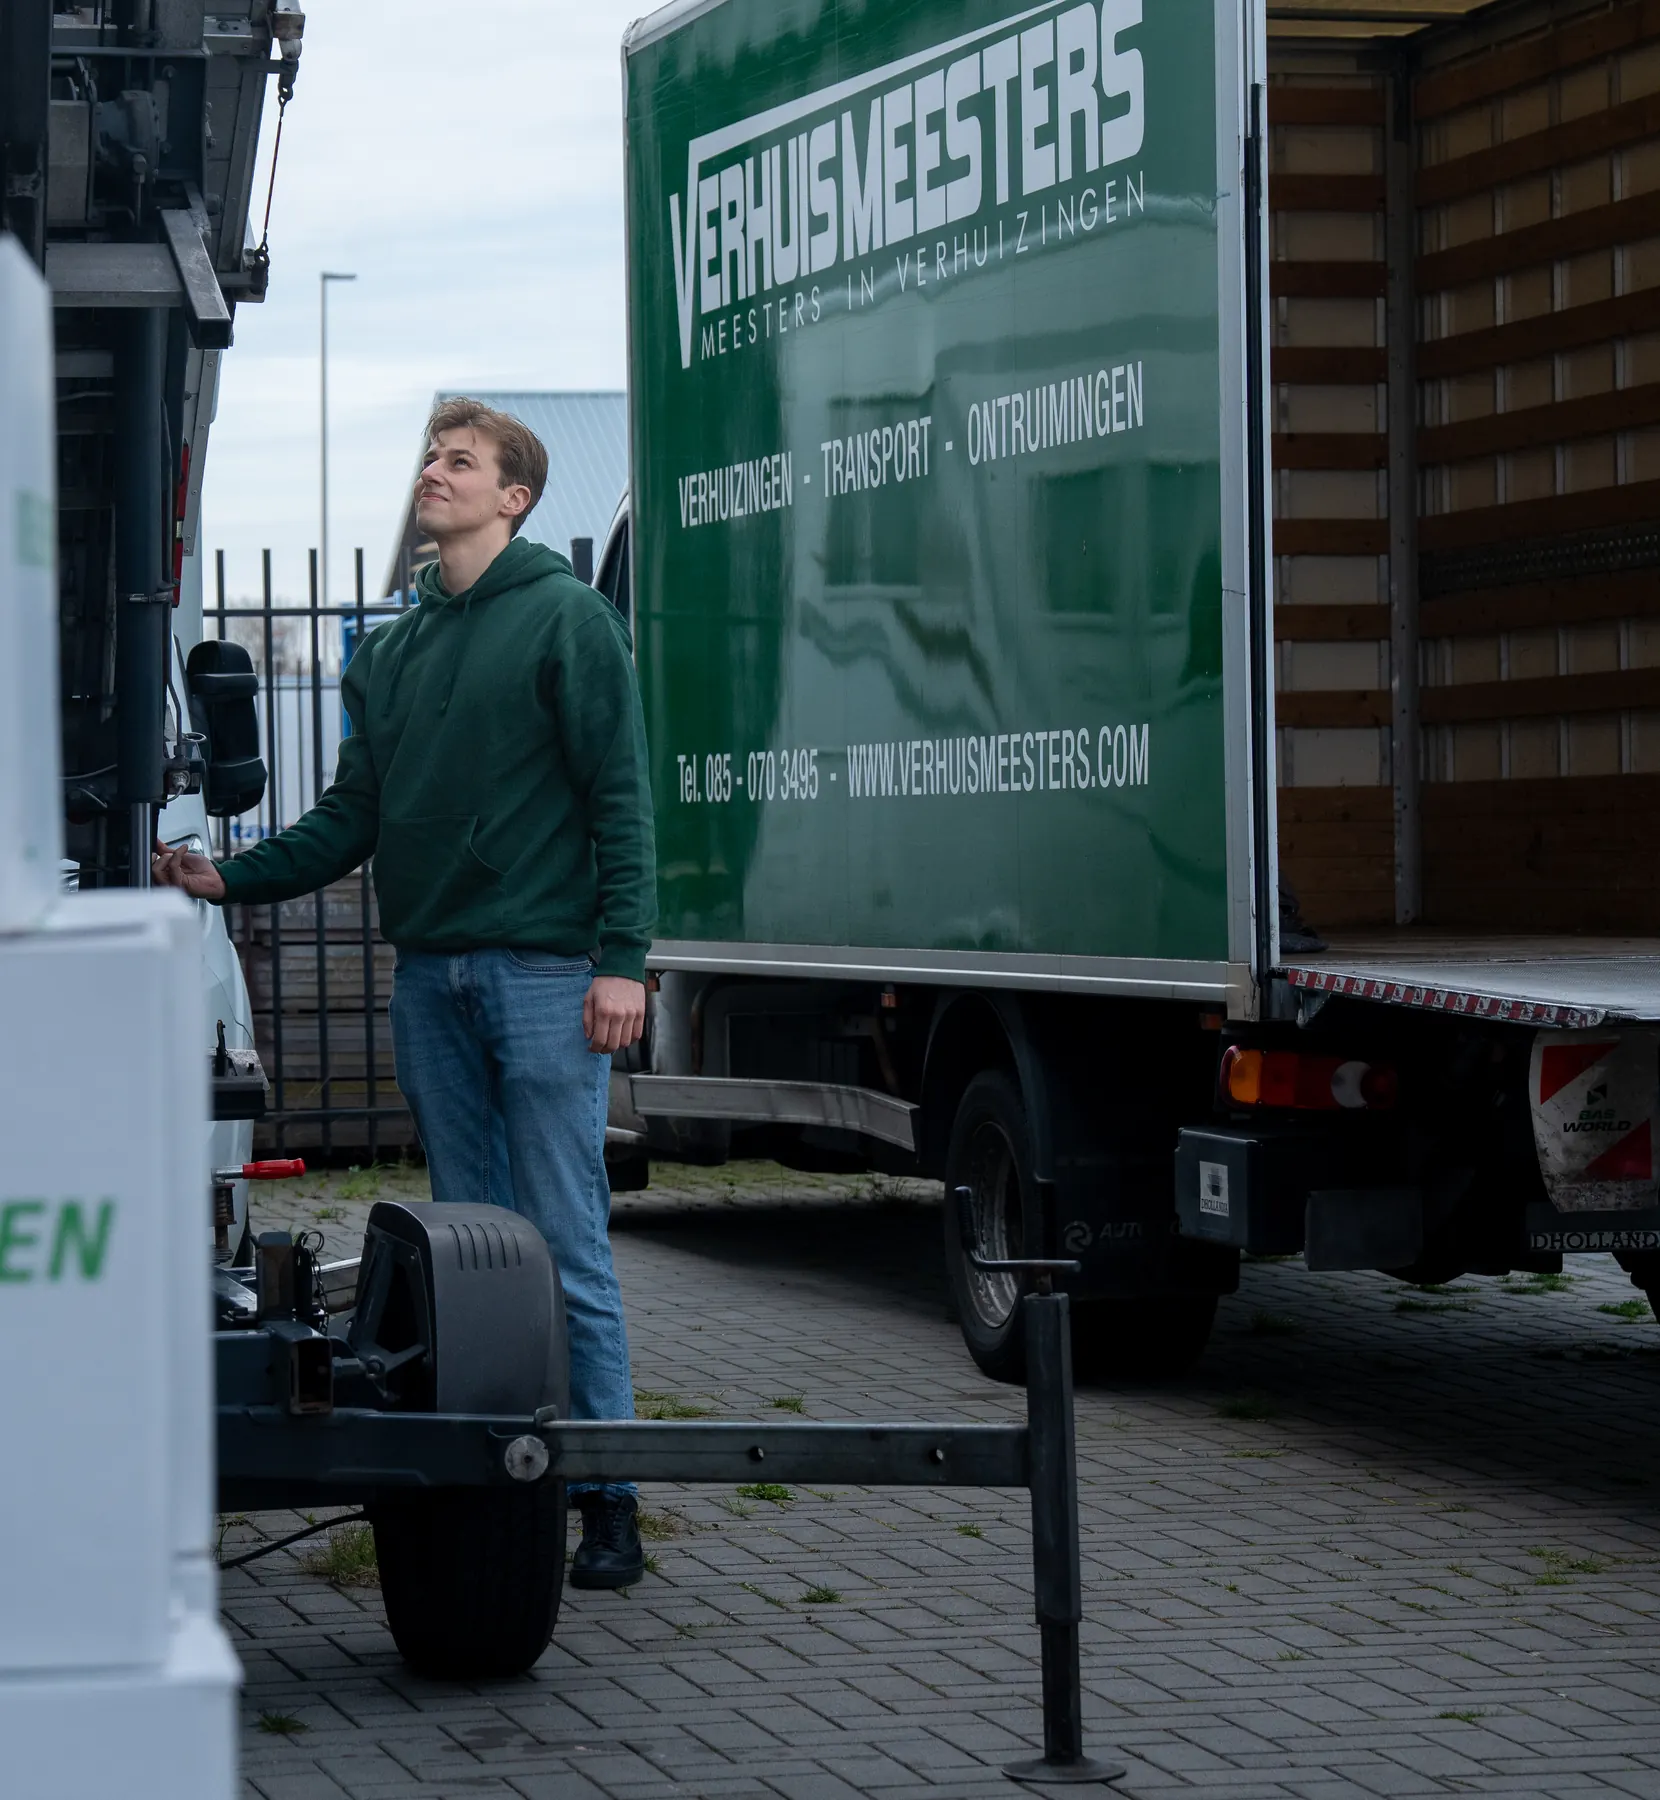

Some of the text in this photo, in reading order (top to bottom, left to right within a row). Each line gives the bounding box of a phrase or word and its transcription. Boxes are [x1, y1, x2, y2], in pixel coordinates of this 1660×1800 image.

[669, 0, 1145, 369] VERHUISMEESTERS
[701, 171, 1145, 360] MEESTERS IN VERHUIZINGEN
[678, 451, 792, 528] VERHUIZINGEN
[821, 416, 932, 497] TRANSPORT
[968, 360, 1144, 466] ONTRUIMINGEN
[677, 755, 702, 803] Tel.
[705, 753, 731, 802] 085
[748, 751, 775, 801] 070
[780, 749, 819, 800] 3495
[847, 723, 1150, 798] WWW.VERHUISMEESTERS.COM
[1563, 1120, 1632, 1133] WORLD
